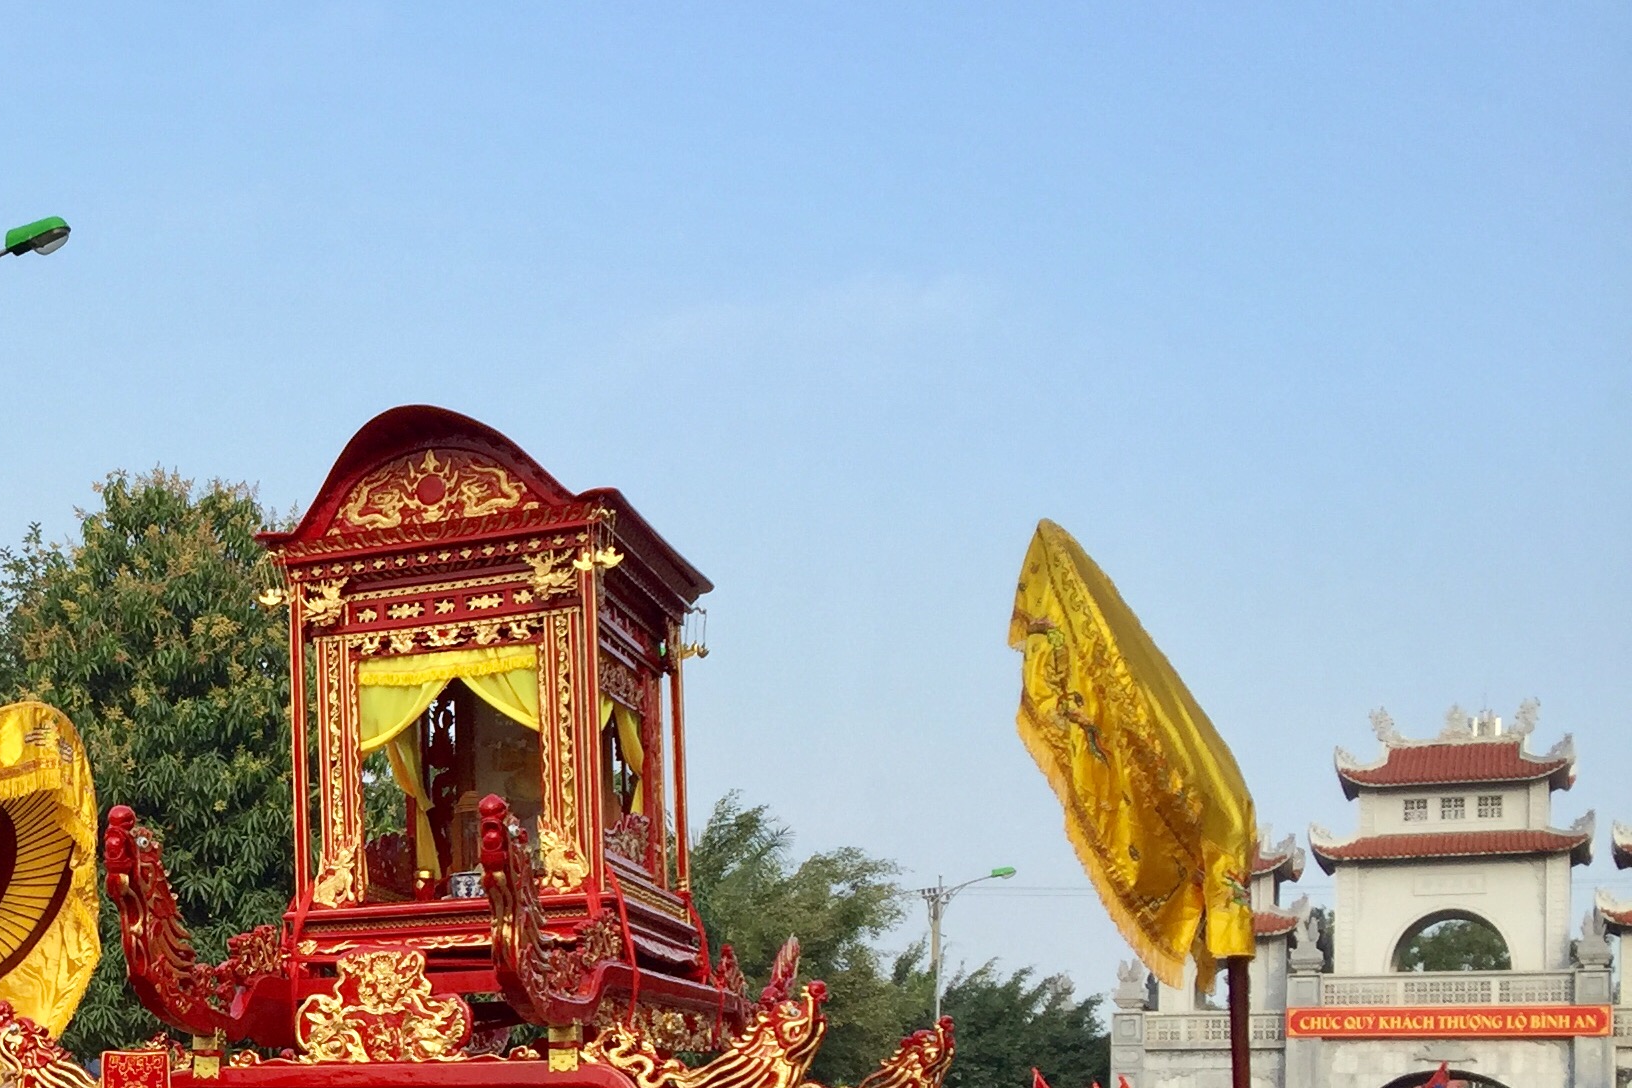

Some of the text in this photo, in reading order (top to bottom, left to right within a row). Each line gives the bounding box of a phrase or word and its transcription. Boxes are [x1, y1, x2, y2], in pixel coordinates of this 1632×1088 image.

[1299, 1011, 1598, 1032] CHÚC QUÝ KHÁCH THƯỢNG LỘ BÌNH AN
